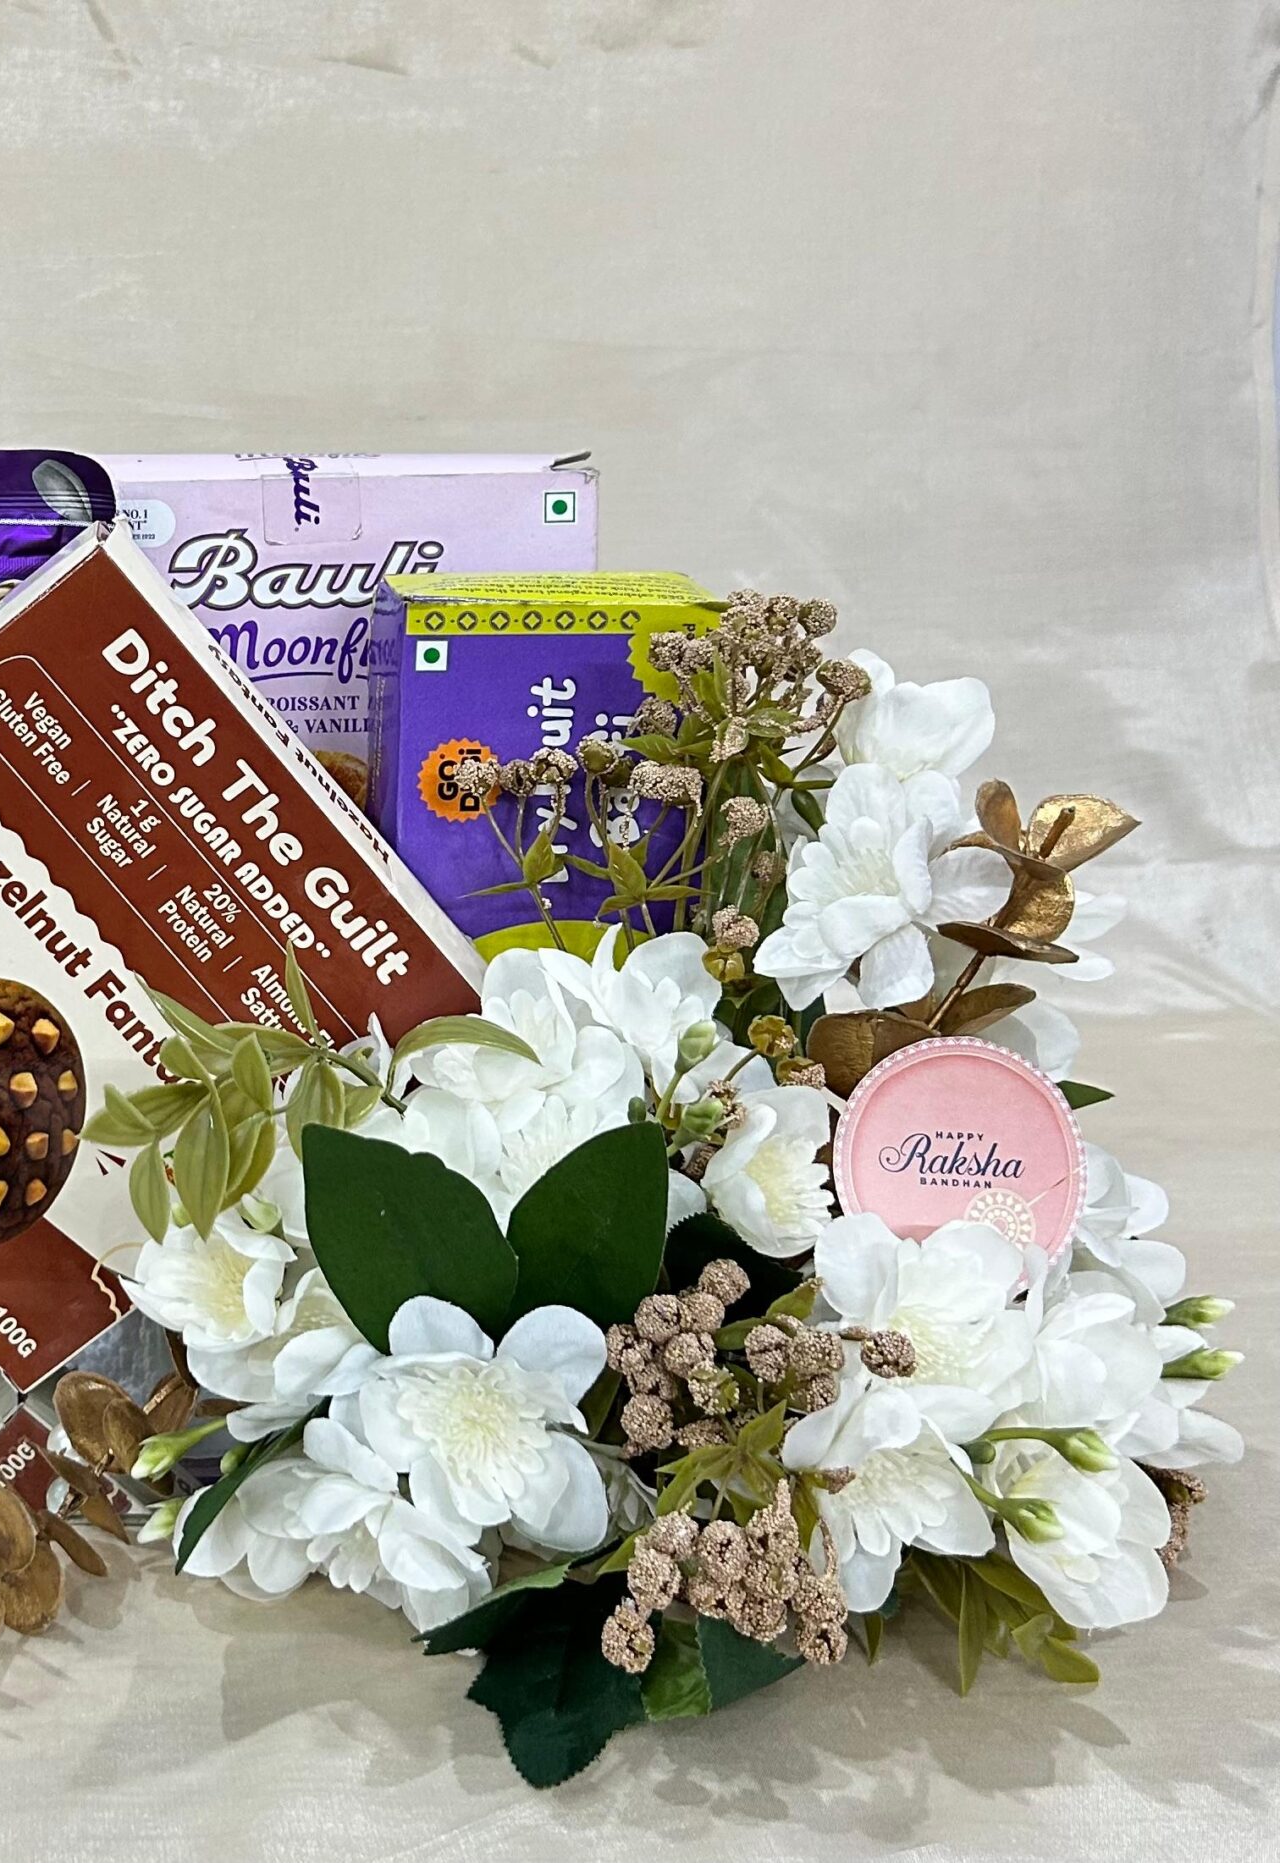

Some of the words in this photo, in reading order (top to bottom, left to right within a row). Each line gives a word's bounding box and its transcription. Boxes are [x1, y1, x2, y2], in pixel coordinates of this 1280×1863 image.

[168, 528, 444, 611] Bauli
[23, 690, 72, 750] Vegan
[267, 695, 360, 712] ROISSANT
[304, 718, 369, 734] VANIL
[32, 741, 71, 785] Free
[207, 643, 291, 749] Fantasy
[294, 746, 394, 865] Hazelnut
[437, 760, 459, 801] GO
[459, 748, 481, 812] Di
[96, 793, 157, 859] Natural
[101, 628, 218, 768] Ditch
[222, 758, 304, 867] The
[304, 865, 411, 986] Guilt
[129, 798, 150, 818] 1
[138, 814, 163, 834] g
[168, 786, 243, 866] SUGAR
[86, 816, 134, 868] Sugar
[174, 884, 236, 950] Natural
[202, 882, 242, 924] 20%
[158, 899, 215, 963] Protein
[240, 986, 288, 1034] Satt
[878, 1132, 1027, 1180] Raksha
[935, 1130, 985, 1142] HAPPY
[920, 1177, 993, 1190] BANDHAN
